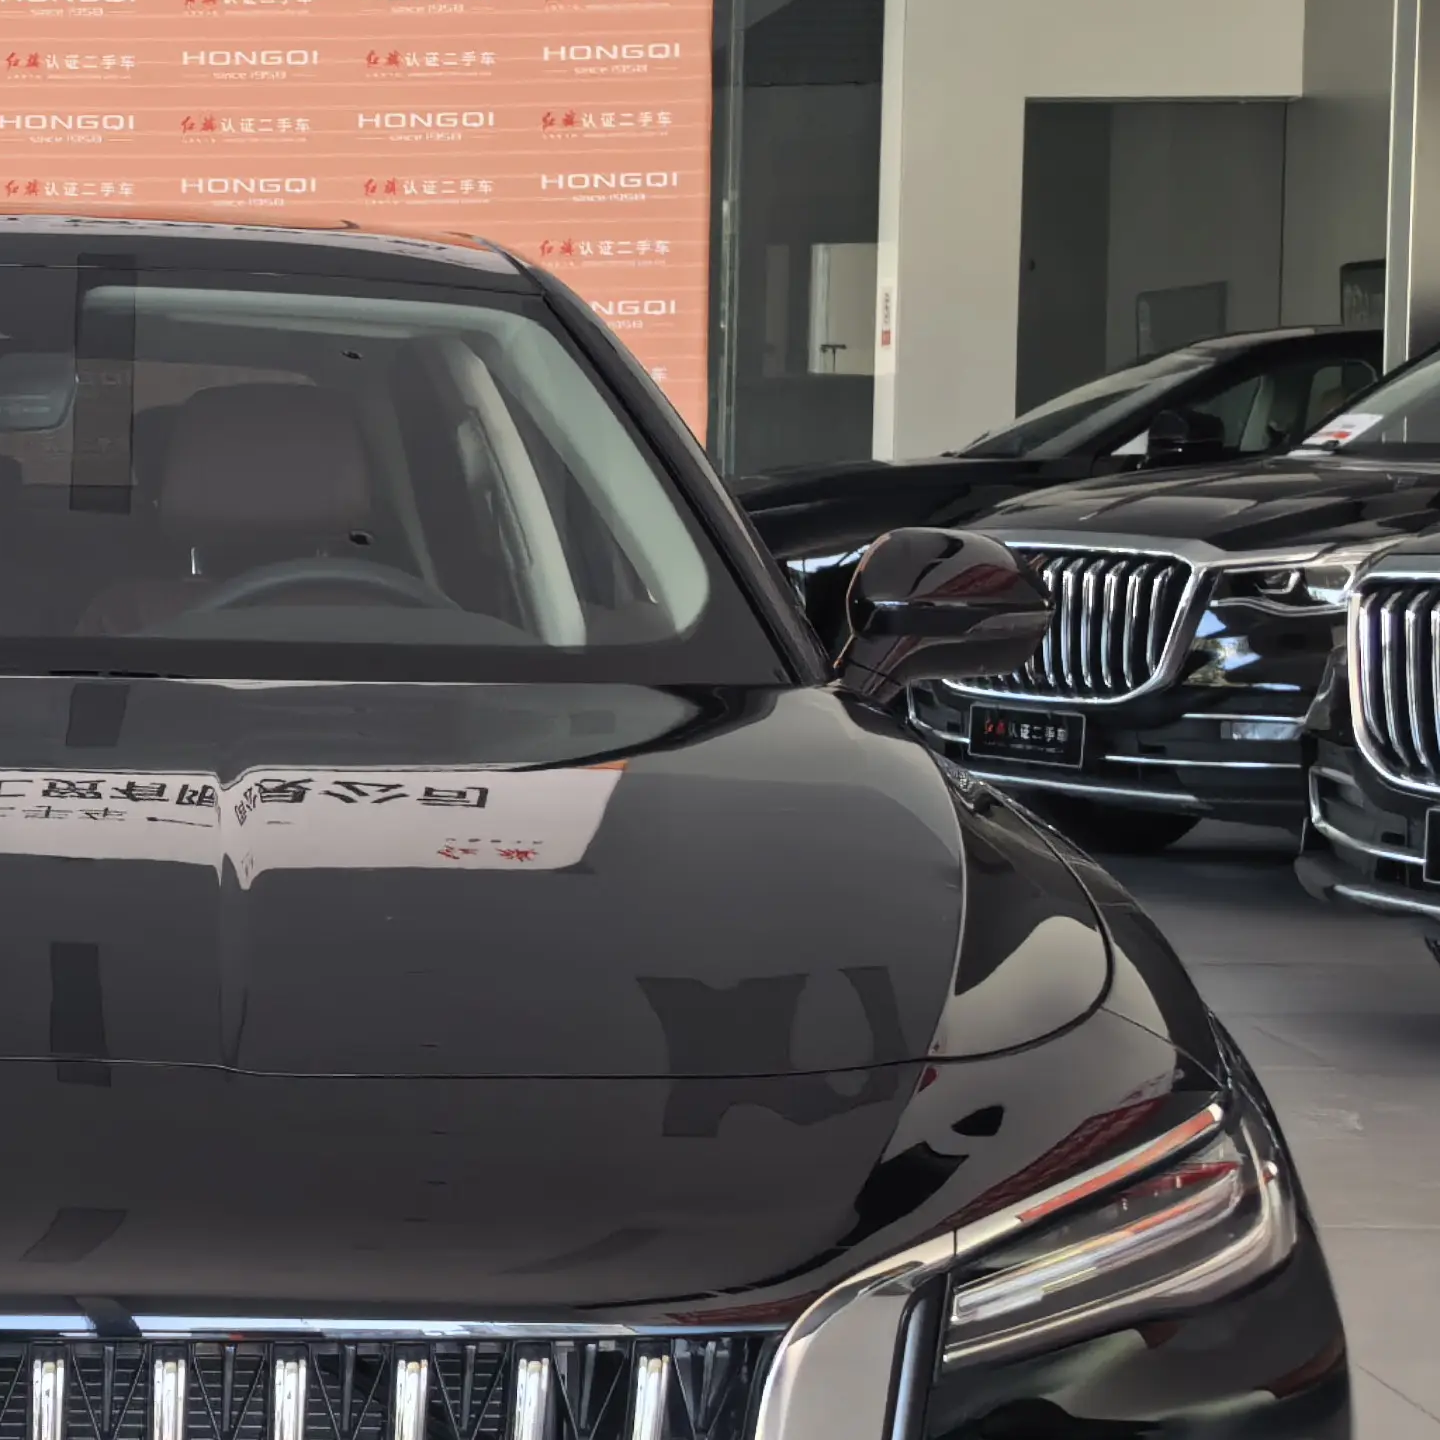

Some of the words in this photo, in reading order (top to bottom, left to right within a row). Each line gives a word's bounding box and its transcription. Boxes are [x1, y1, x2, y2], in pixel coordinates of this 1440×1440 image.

[182, 49, 319, 66] HONGQI
[542, 42, 681, 62] HONGQI
[357, 111, 495, 129] HONGQI
[181, 177, 317, 194] HONGQI
[540, 171, 679, 190] HONGQI
[590, 299, 676, 316] NGQI
